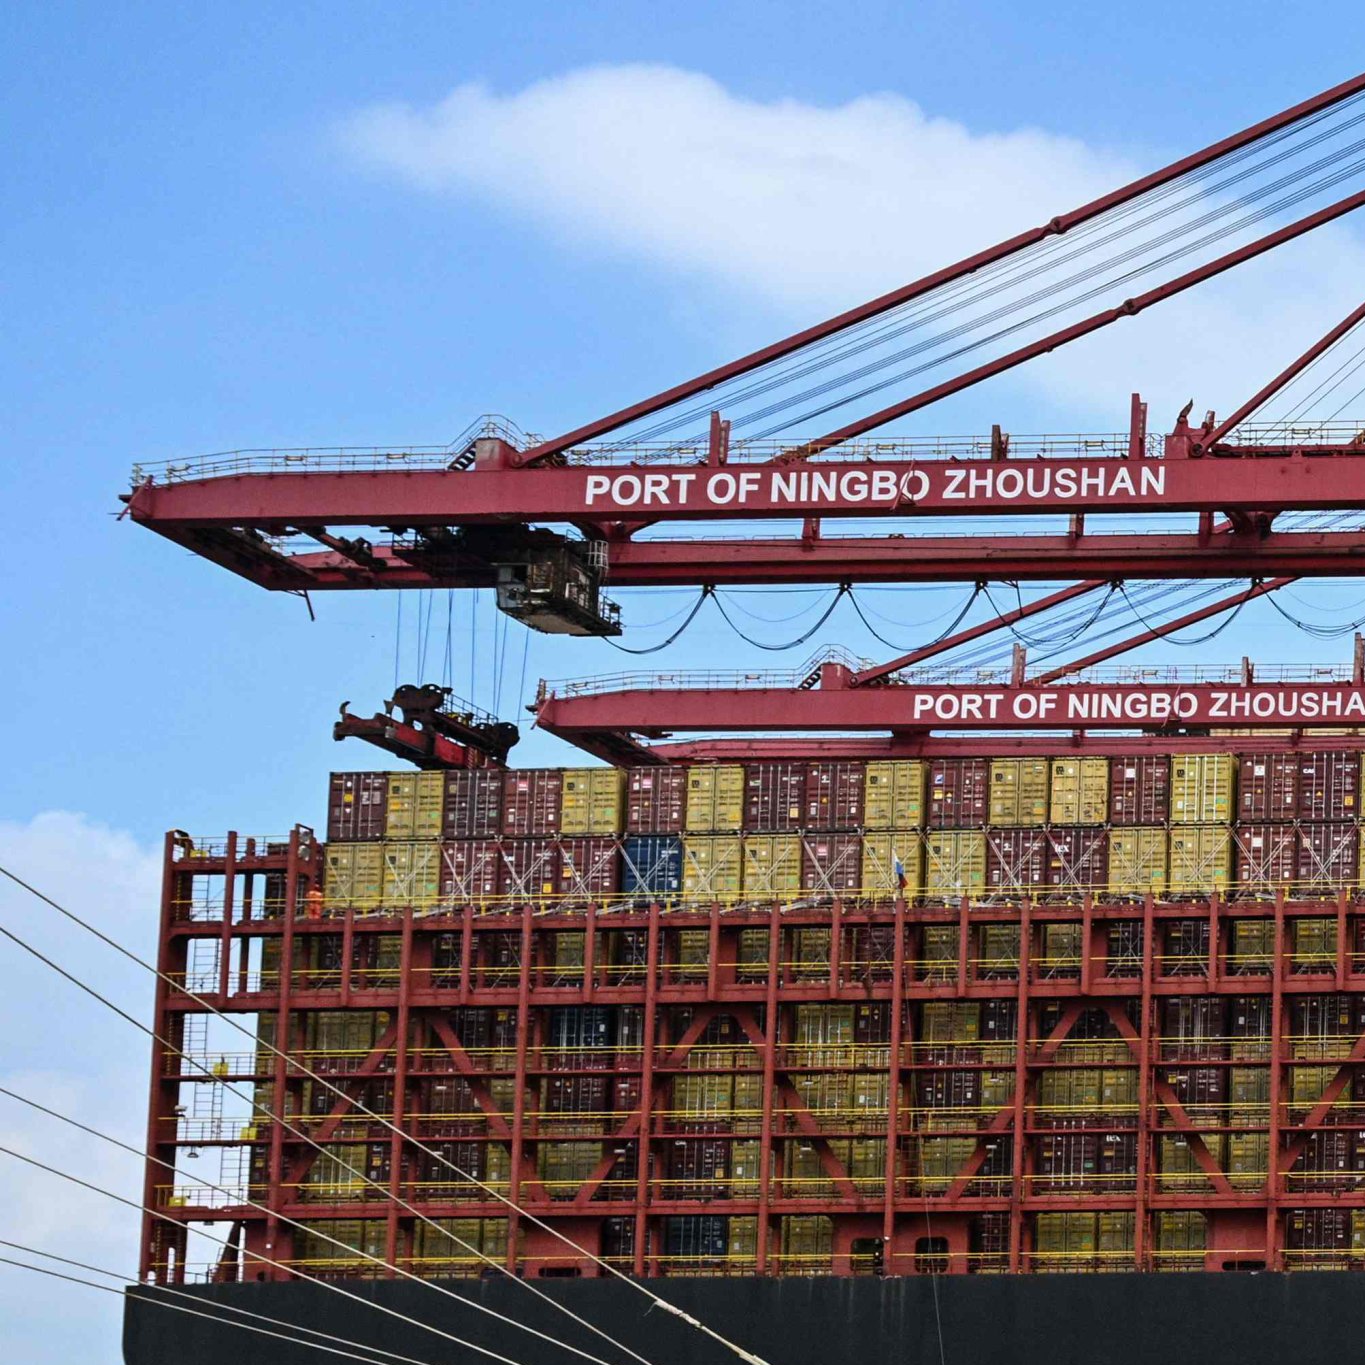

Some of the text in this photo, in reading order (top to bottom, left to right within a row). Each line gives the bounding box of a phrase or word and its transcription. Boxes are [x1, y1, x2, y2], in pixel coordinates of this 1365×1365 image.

[585, 466, 1166, 505] PORT OF NINGBO ZHOUSHAN
[914, 694, 1003, 719] PORT
[1013, 694, 1056, 719] OF
[1068, 693, 1197, 719] NINGBO
